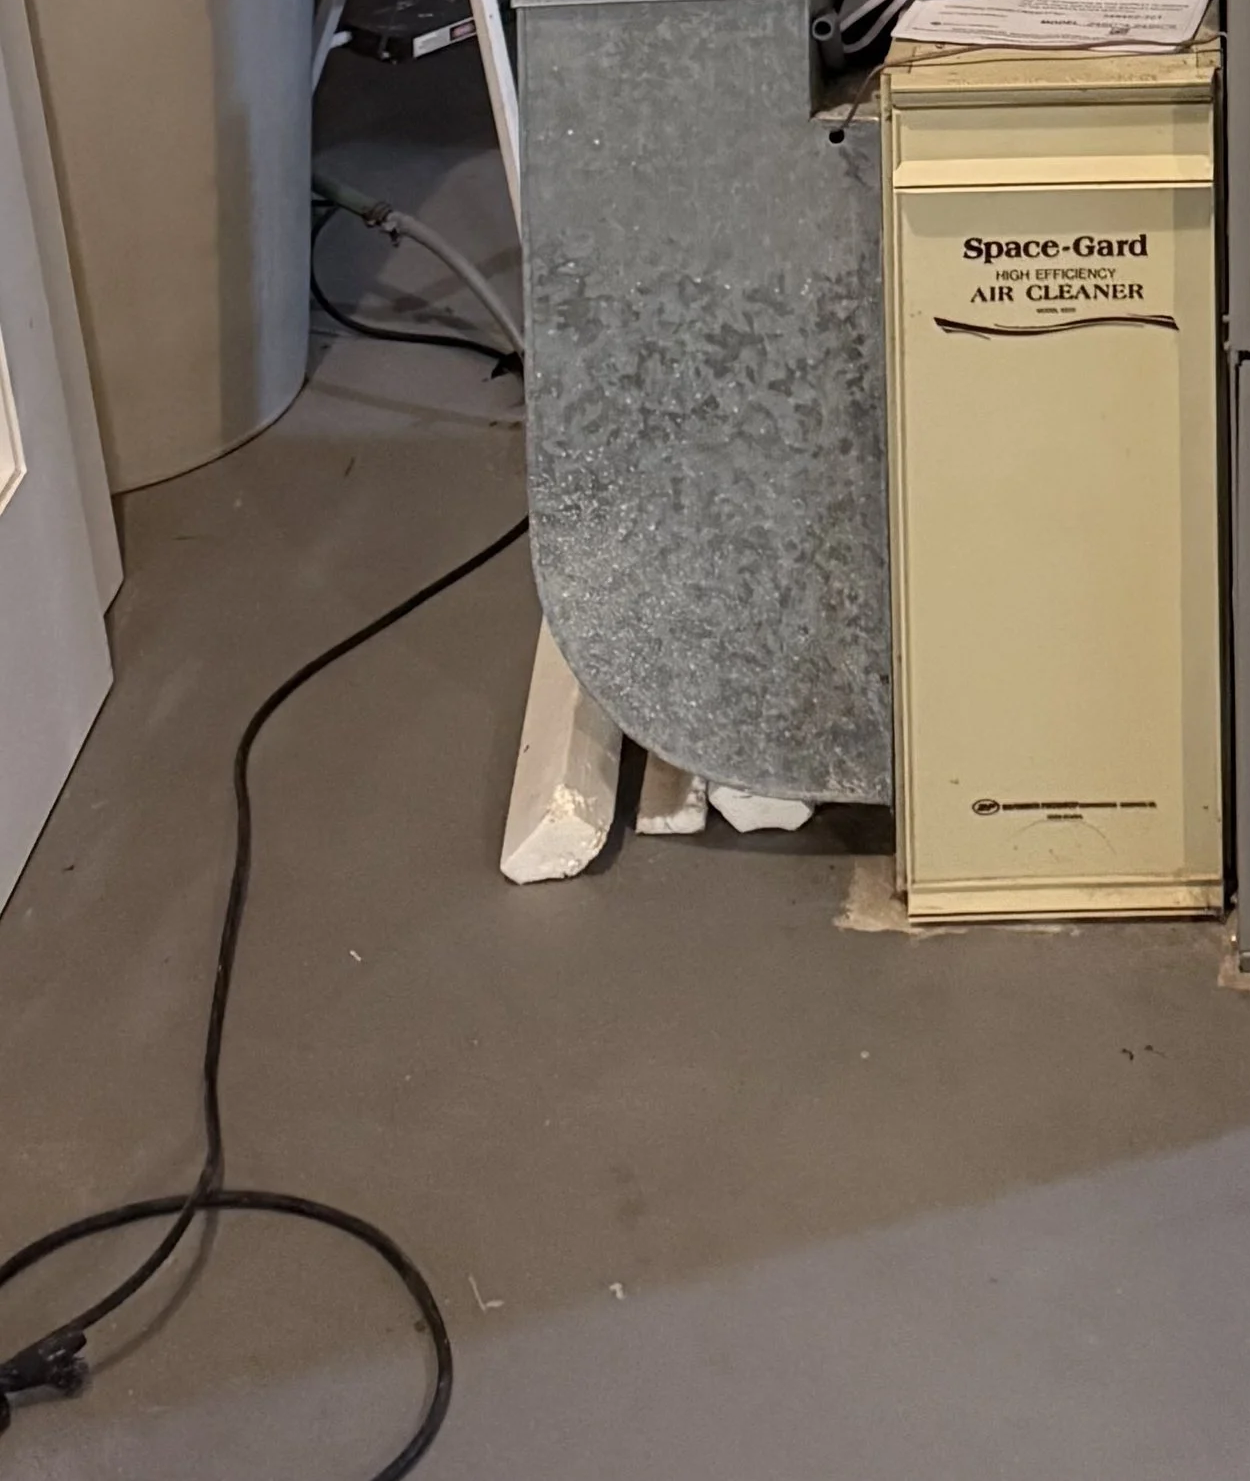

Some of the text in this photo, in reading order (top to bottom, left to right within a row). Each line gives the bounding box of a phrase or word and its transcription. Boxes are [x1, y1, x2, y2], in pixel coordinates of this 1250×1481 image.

[963, 234, 1148, 264] Space-Gard
[996, 267, 1116, 281] HIGH EFFICIENCY
[970, 283, 1144, 303] AIR CLEANER
